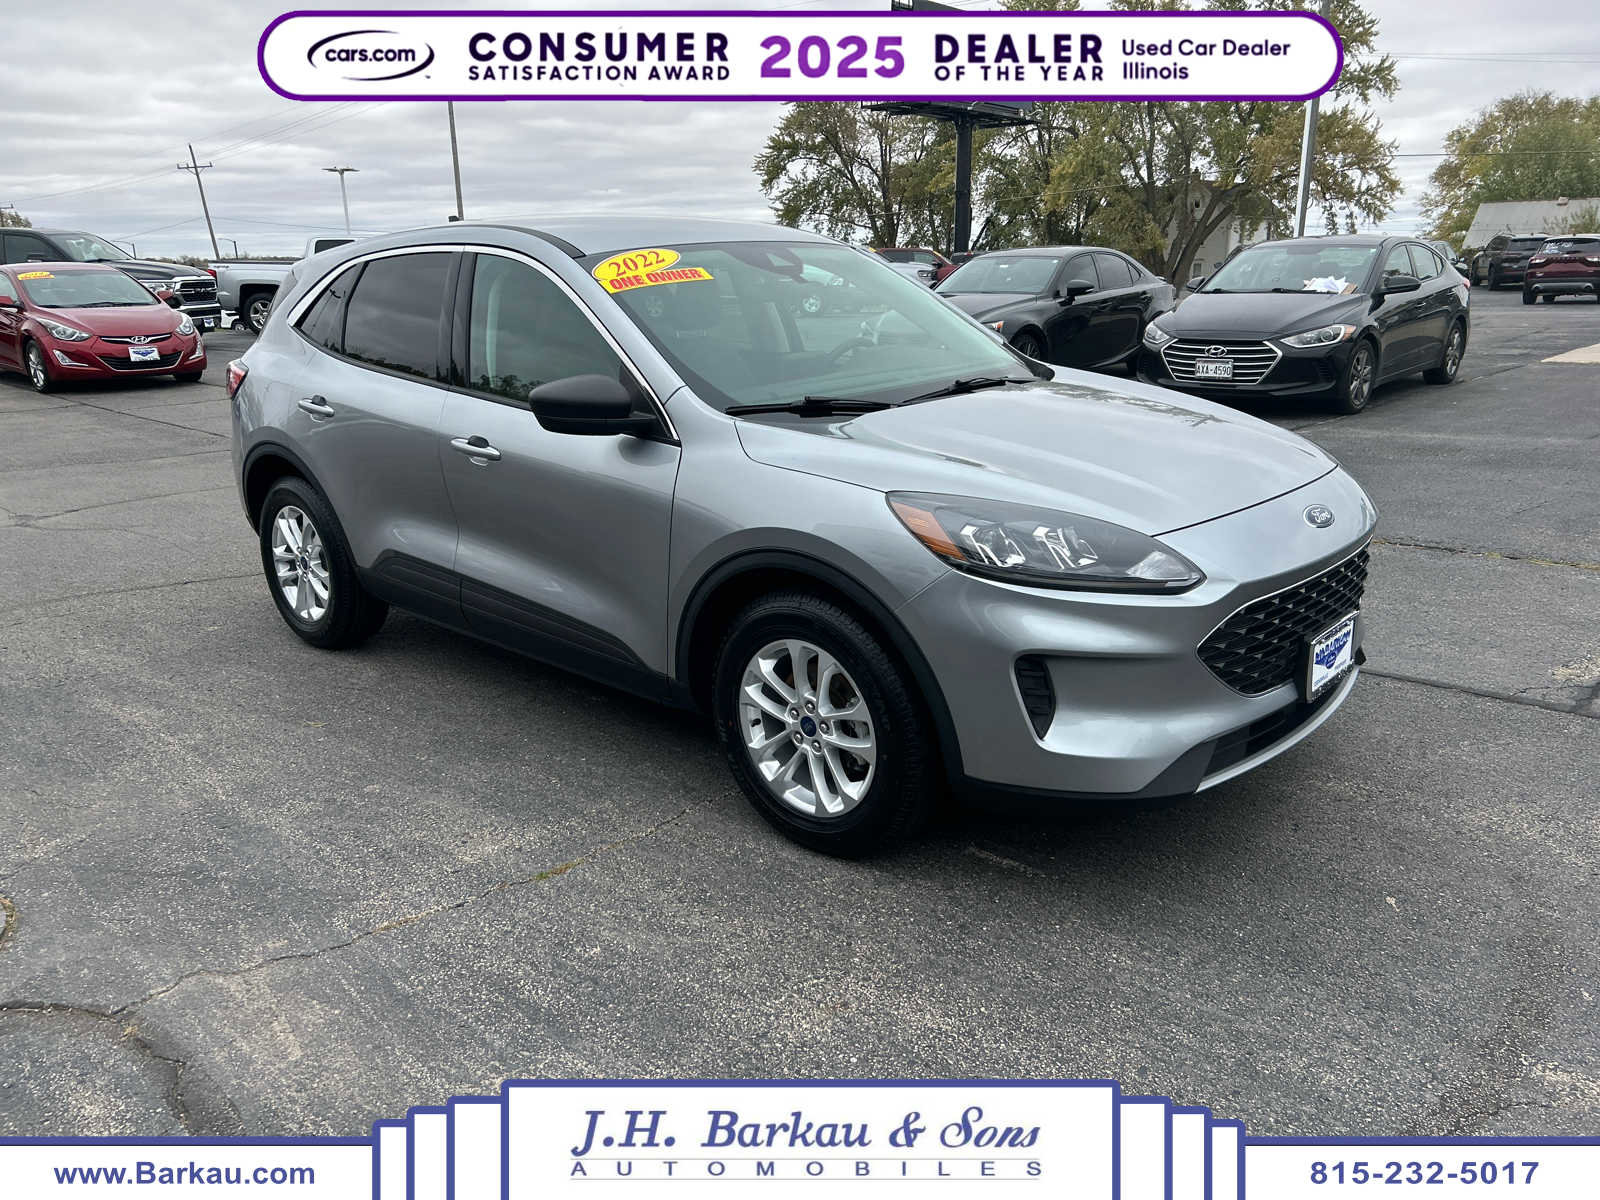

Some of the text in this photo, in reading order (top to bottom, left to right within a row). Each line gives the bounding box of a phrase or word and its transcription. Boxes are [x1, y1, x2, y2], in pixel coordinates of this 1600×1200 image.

[608, 250, 665, 277] 2022
[609, 268, 704, 290] ONE OWNER
